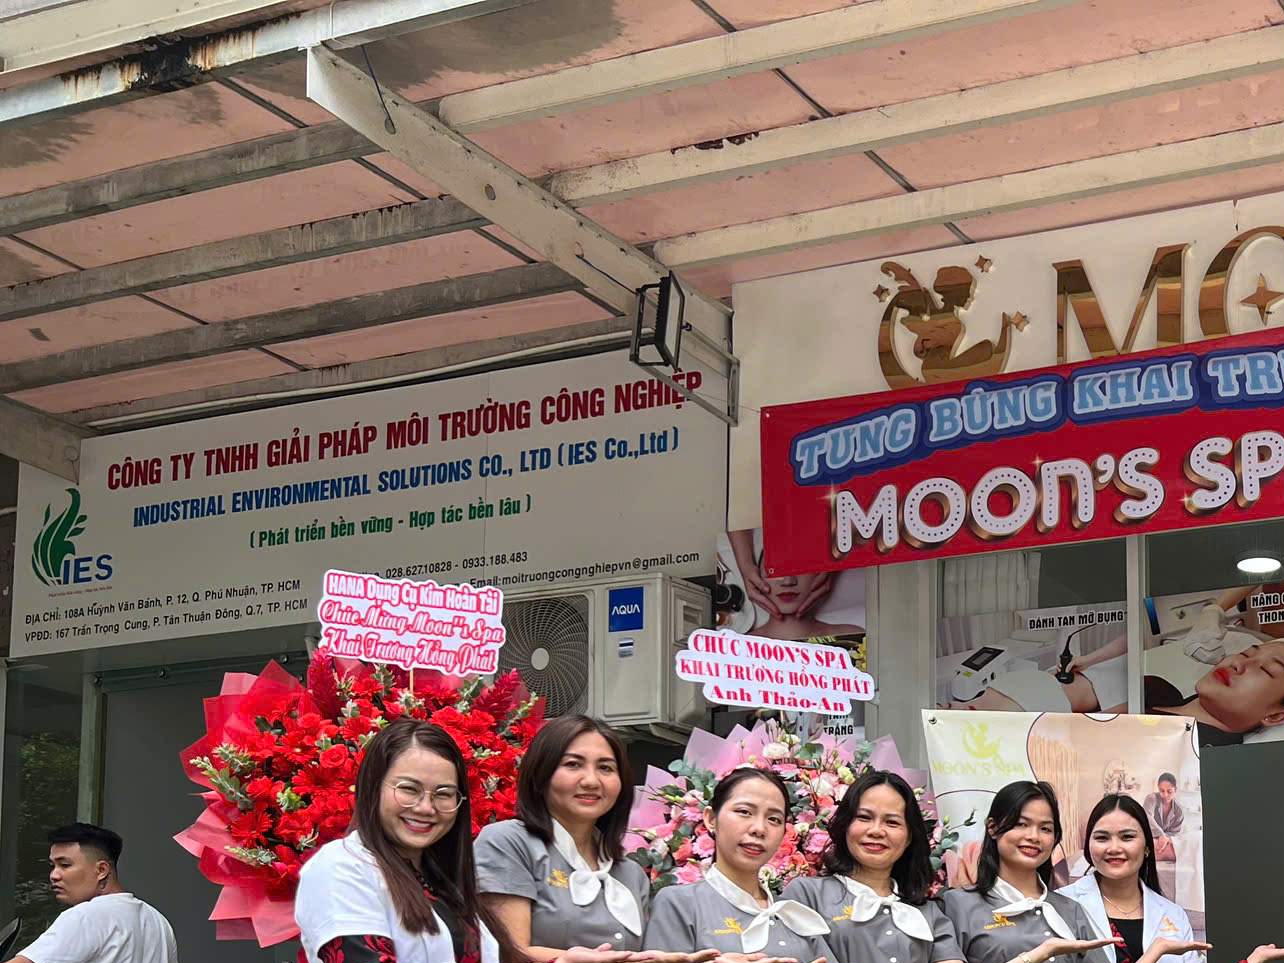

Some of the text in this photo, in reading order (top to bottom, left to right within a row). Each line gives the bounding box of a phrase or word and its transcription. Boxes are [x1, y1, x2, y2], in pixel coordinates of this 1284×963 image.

[1073, 360, 1193, 415] KHAI
[107, 456, 162, 491] CÔNG
[170, 452, 195, 482] TY
[204, 442, 259, 477] TNHH
[266, 427, 310, 468] GIẢI
[318, 421, 378, 461] PHÁP
[386, 412, 429, 450] MÔI
[438, 398, 532, 442] TRƯỜNG
[540, 387, 605, 425] CÔNG
[133, 494, 226, 528] INDUSTRIAL
[231, 474, 371, 514] ENVIRONMENTAL
[378, 458, 472, 493] SOLUTIONS
[479, 454, 513, 478] CO.,
[519, 447, 551, 473] LTD
[832, 446, 1166, 559] MOON'S
[330, 516, 355, 540] bền
[409, 509, 435, 531] Hợp
[441, 503, 463, 524] tác
[468, 496, 494, 521] bền
[61, 553, 114, 586] IES
[462, 551, 529, 570] 0933.188.483
[64, 608, 85, 620] 108A
[204, 589, 223, 601] Phú
[277, 579, 300, 592] HCM
[327, 572, 366, 599] HANA
[419, 582, 445, 609] Kim
[1251, 592, 1279, 607] NÂNG
[55, 628, 70, 639] 167
[94, 623, 120, 635] Trọng
[284, 598, 308, 612] HCM
[611, 603, 641, 616] AQUA
[1029, 616, 1055, 630] ĐÁNH
[1057, 615, 1075, 627] TAN
[1258, 610, 1284, 623] THON
[471, 618, 505, 647] Spa
[692, 632, 742, 657] CHÚC
[815, 650, 848, 671] SPA
[680, 658, 721, 678] KHAI
[832, 675, 870, 695] PHÁT
[709, 685, 752, 703] Anh
